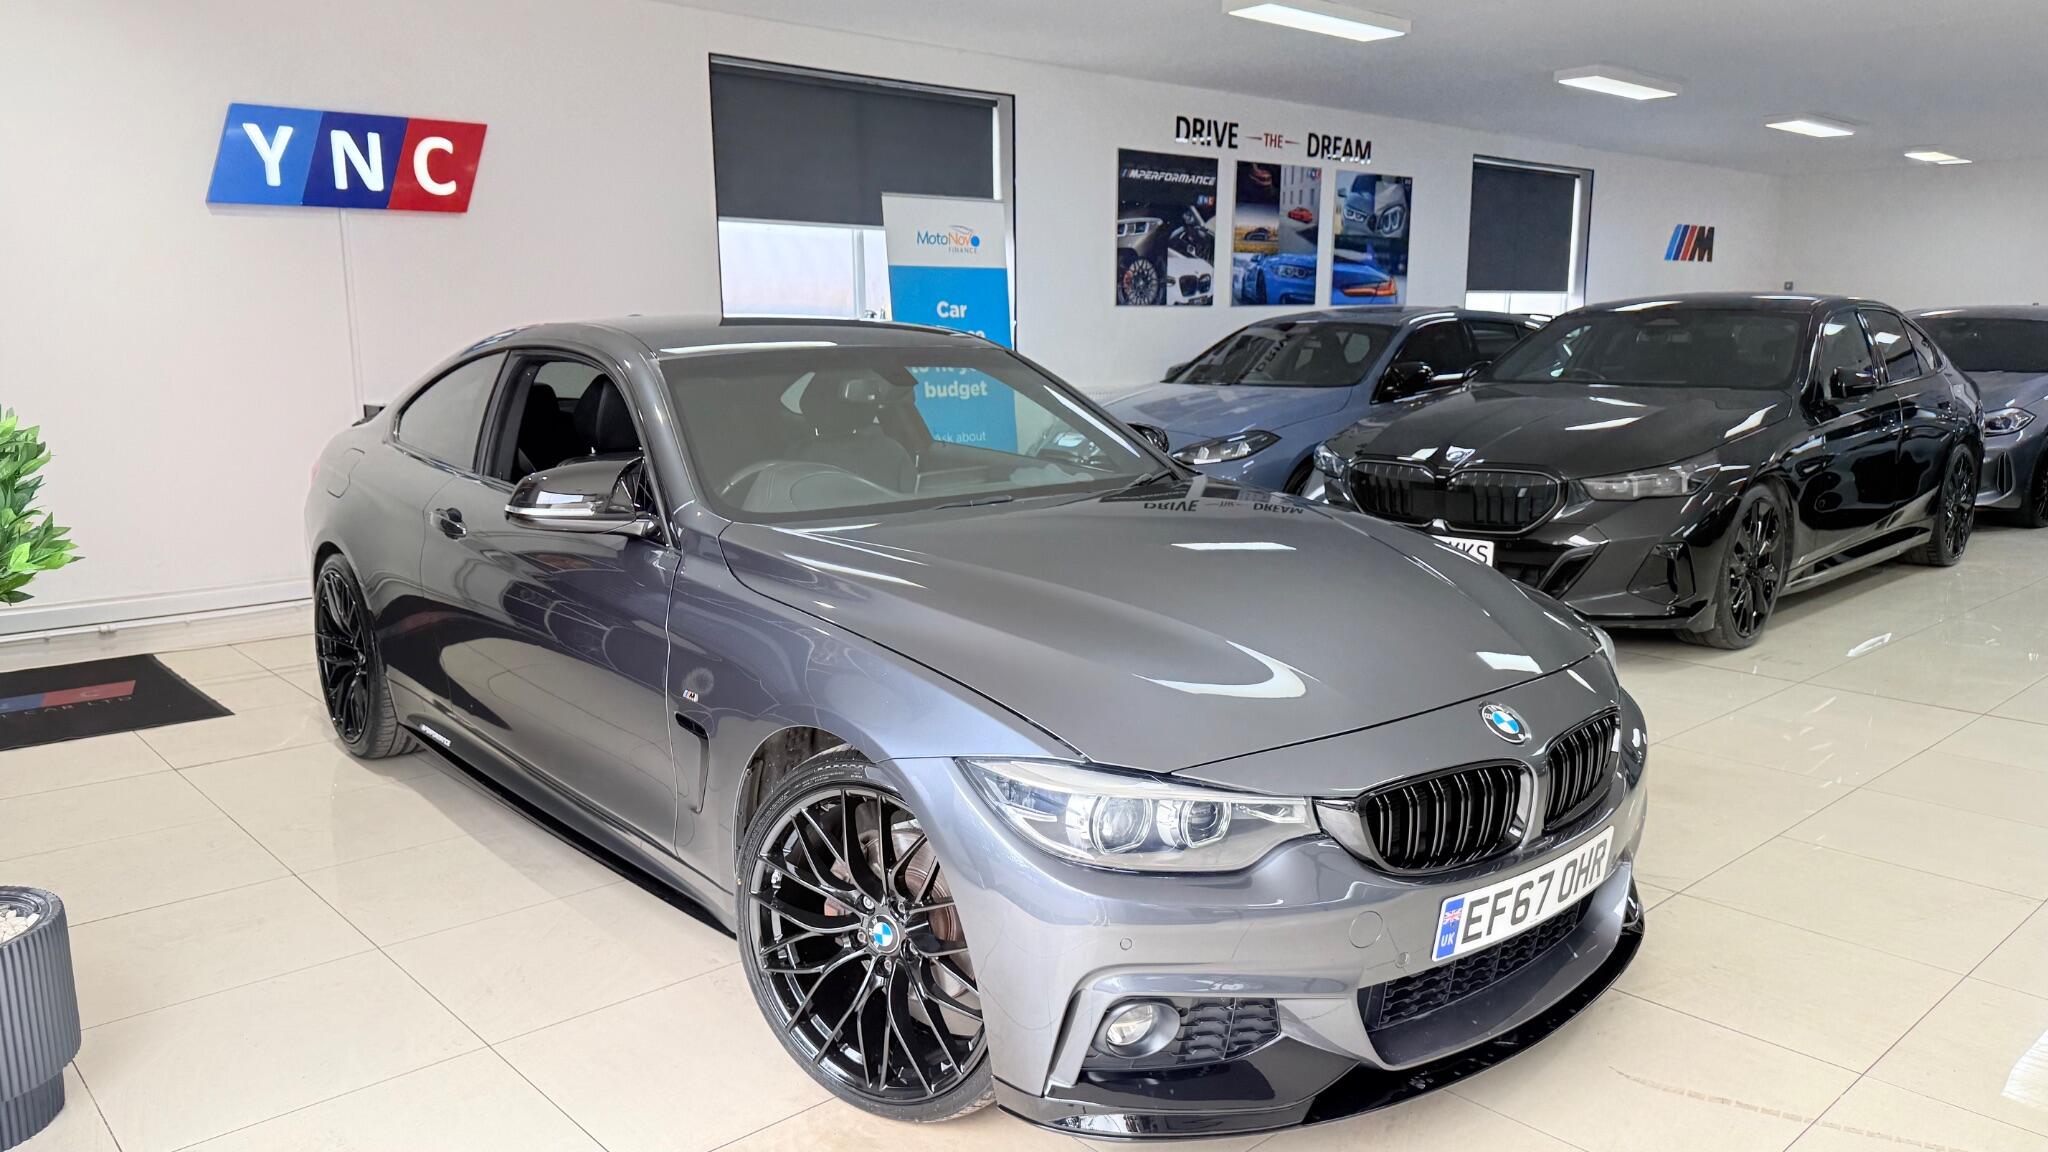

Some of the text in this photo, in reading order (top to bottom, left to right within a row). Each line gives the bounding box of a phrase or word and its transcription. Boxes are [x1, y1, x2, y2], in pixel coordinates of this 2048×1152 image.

[1175, 115, 1372, 164] DRIVE THE DREAM
[242, 122, 457, 196] YNC
[936, 301, 967, 318] Car
[924, 380, 988, 400] budget
[956, 431, 987, 443] about
[1461, 838, 1609, 944] EF67 OHR
[1440, 932, 1455, 947] UK
